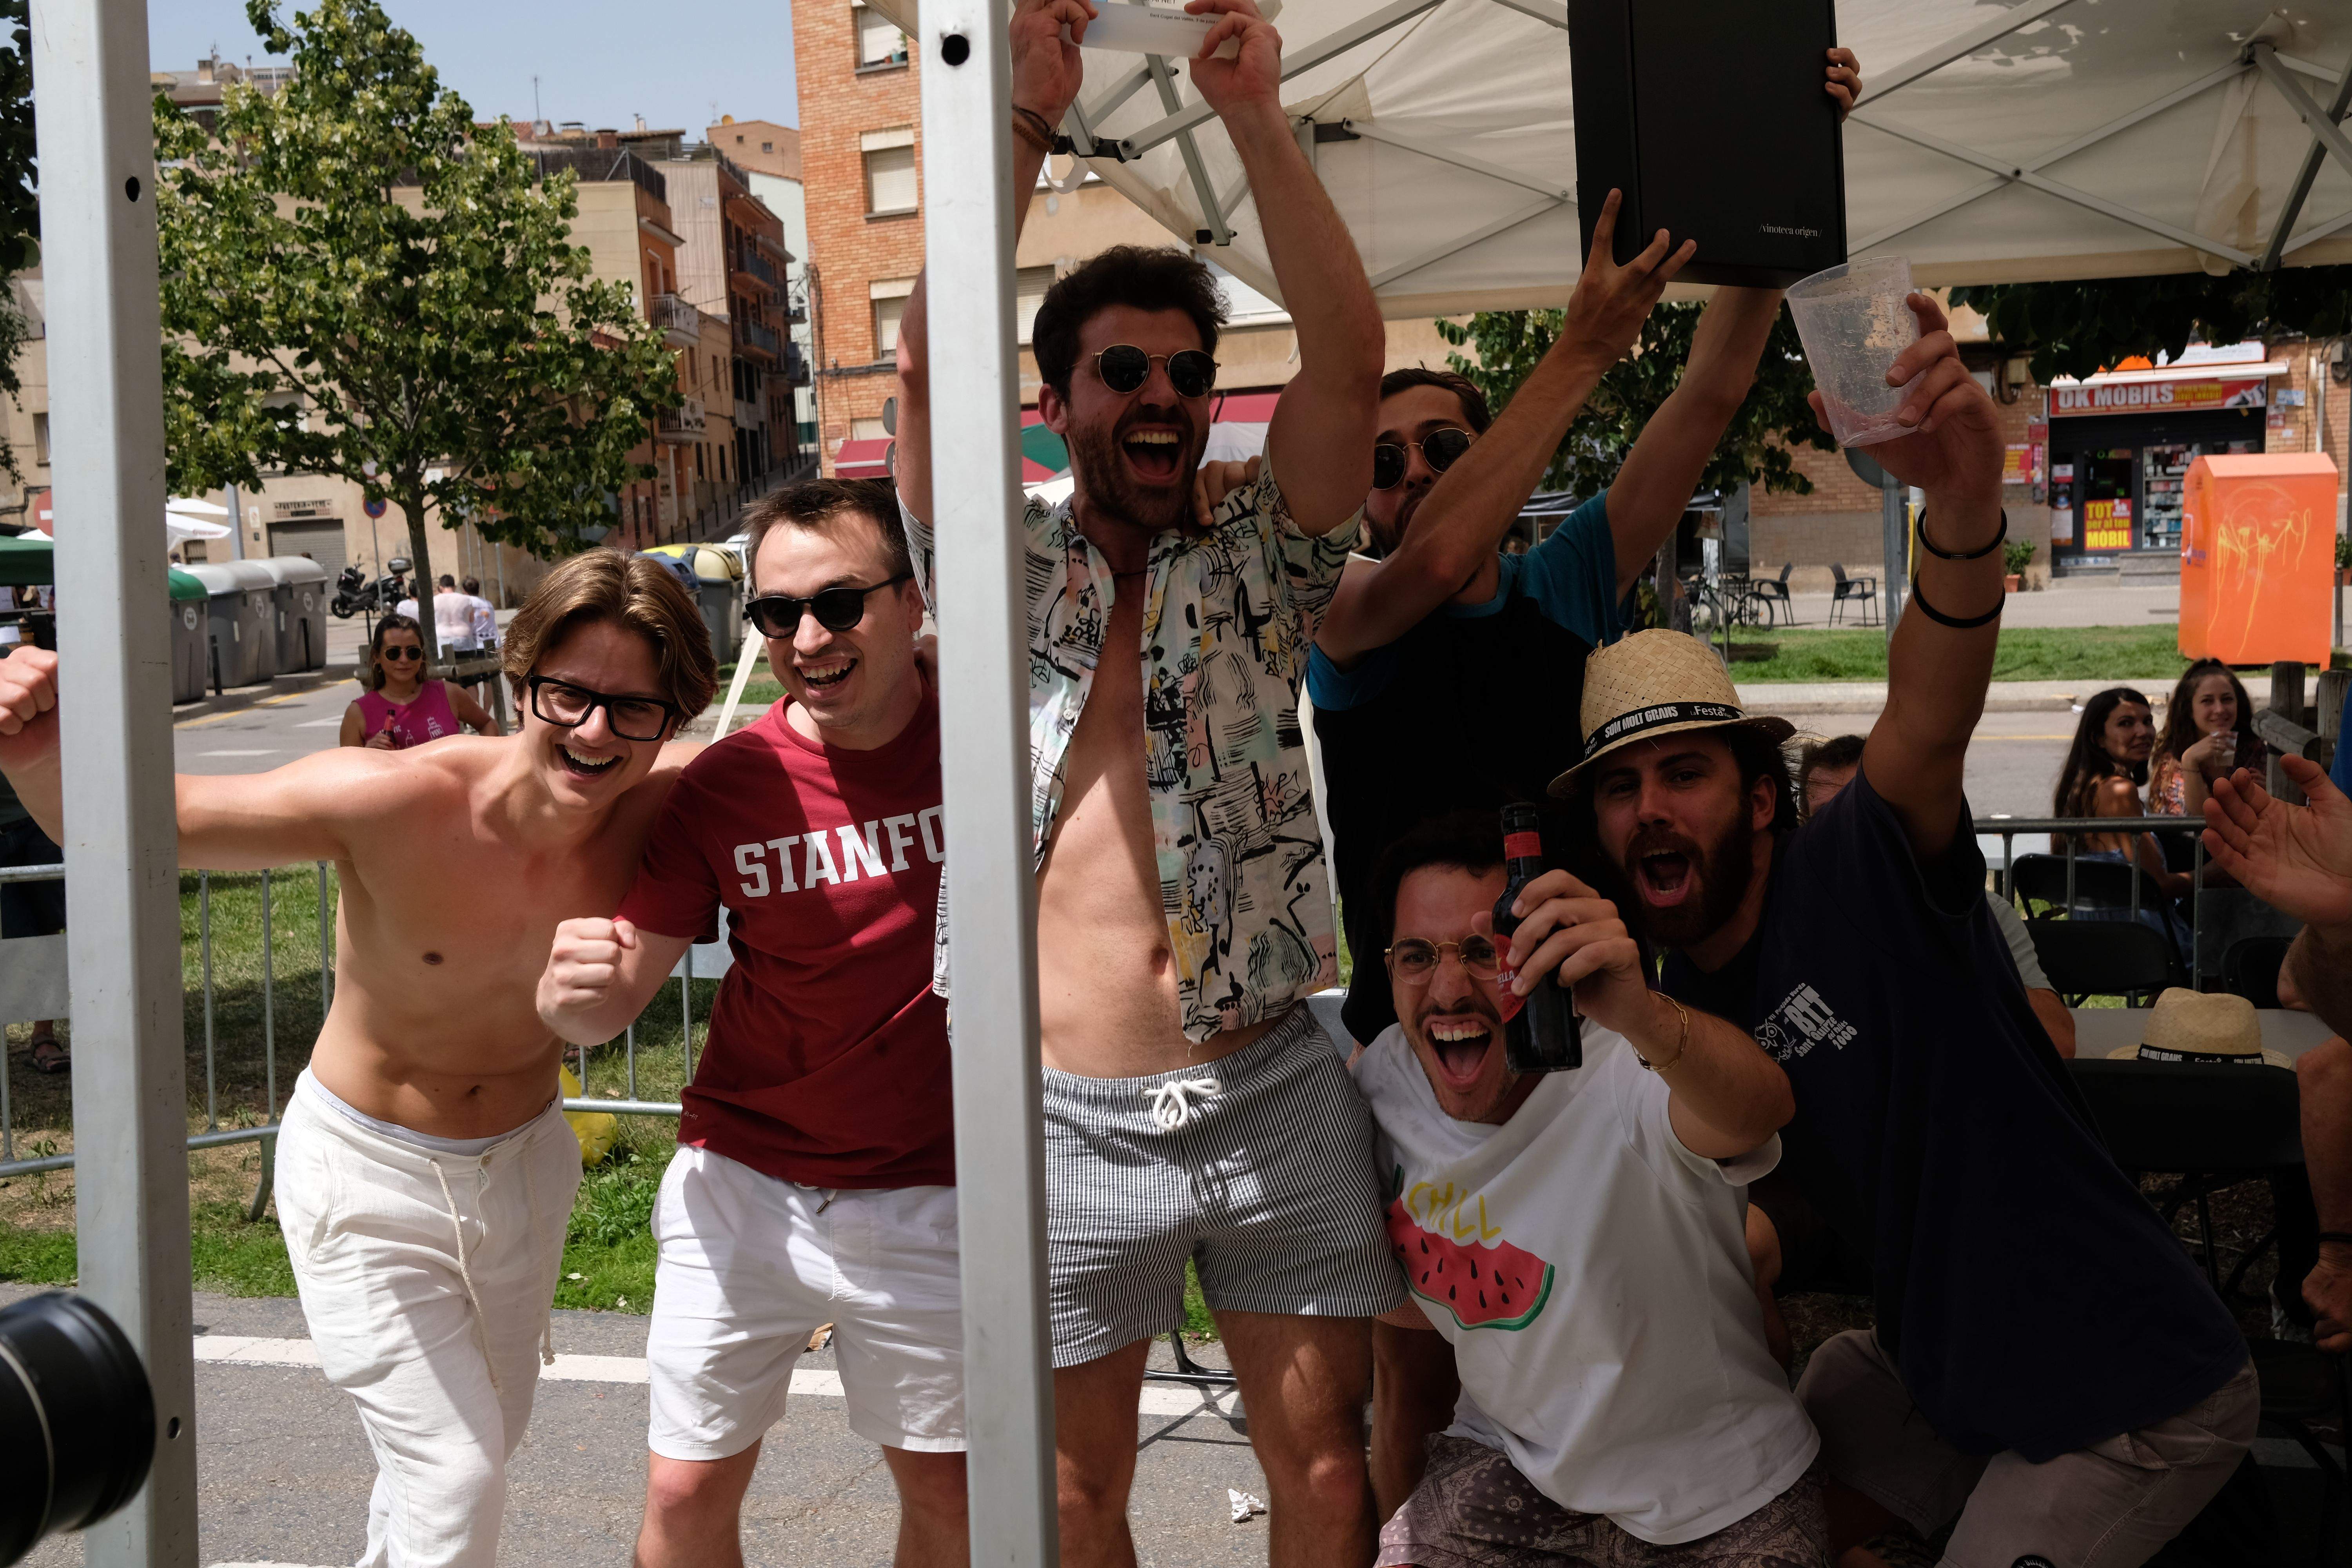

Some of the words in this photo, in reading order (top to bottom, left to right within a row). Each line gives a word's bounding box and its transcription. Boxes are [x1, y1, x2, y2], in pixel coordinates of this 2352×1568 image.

[2059, 388, 2090, 408] OK
[2094, 382, 2174, 407] MÒBILS
[2086, 502, 2113, 519] TOT
[2086, 520, 2102, 530] per
[2104, 518, 2113, 528] al
[2115, 518, 2130, 528] teu
[1605, 720, 1621, 738] SOM
[1622, 713, 1644, 730] MOLT
[1644, 706, 1679, 722] GRANS
[1693, 706, 1724, 717] Festa
[734, 804, 944, 897] STANFO
[1784, 985, 1834, 1037] BTT
[1794, 1038, 1815, 1057] Sant
[1810, 1016, 1837, 1041] Quirze
[1828, 1030, 1836, 1040] del
[1832, 1025, 1858, 1051] 2000
[1408, 1181, 1502, 1240] CHILL
